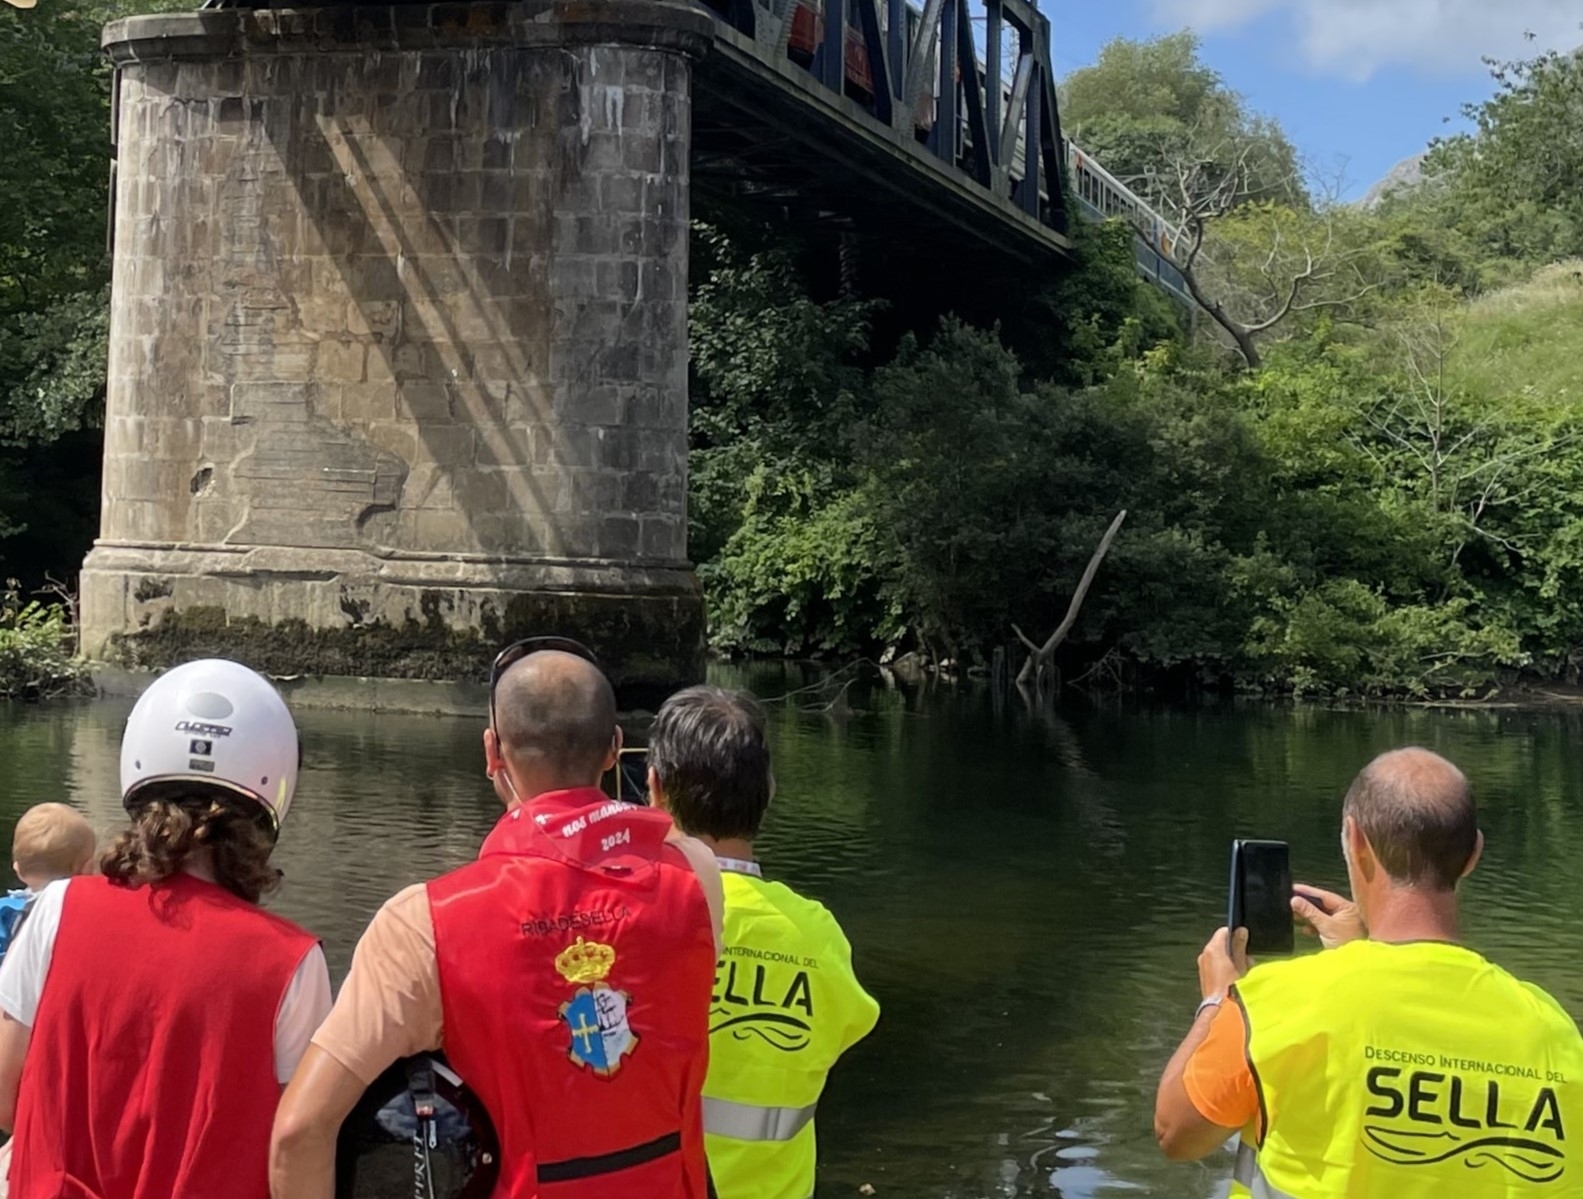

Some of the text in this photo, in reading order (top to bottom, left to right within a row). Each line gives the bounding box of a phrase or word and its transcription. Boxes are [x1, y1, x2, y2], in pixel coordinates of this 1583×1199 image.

[562, 815, 588, 838] nos
[601, 827, 631, 851] 2024
[723, 946, 820, 969] INTERNACIONAL DEL
[712, 960, 814, 1017] LLA
[1365, 1046, 1568, 1084] DESCENSO INTERNACIONAL DEL
[1365, 1066, 1566, 1141] SELLA
